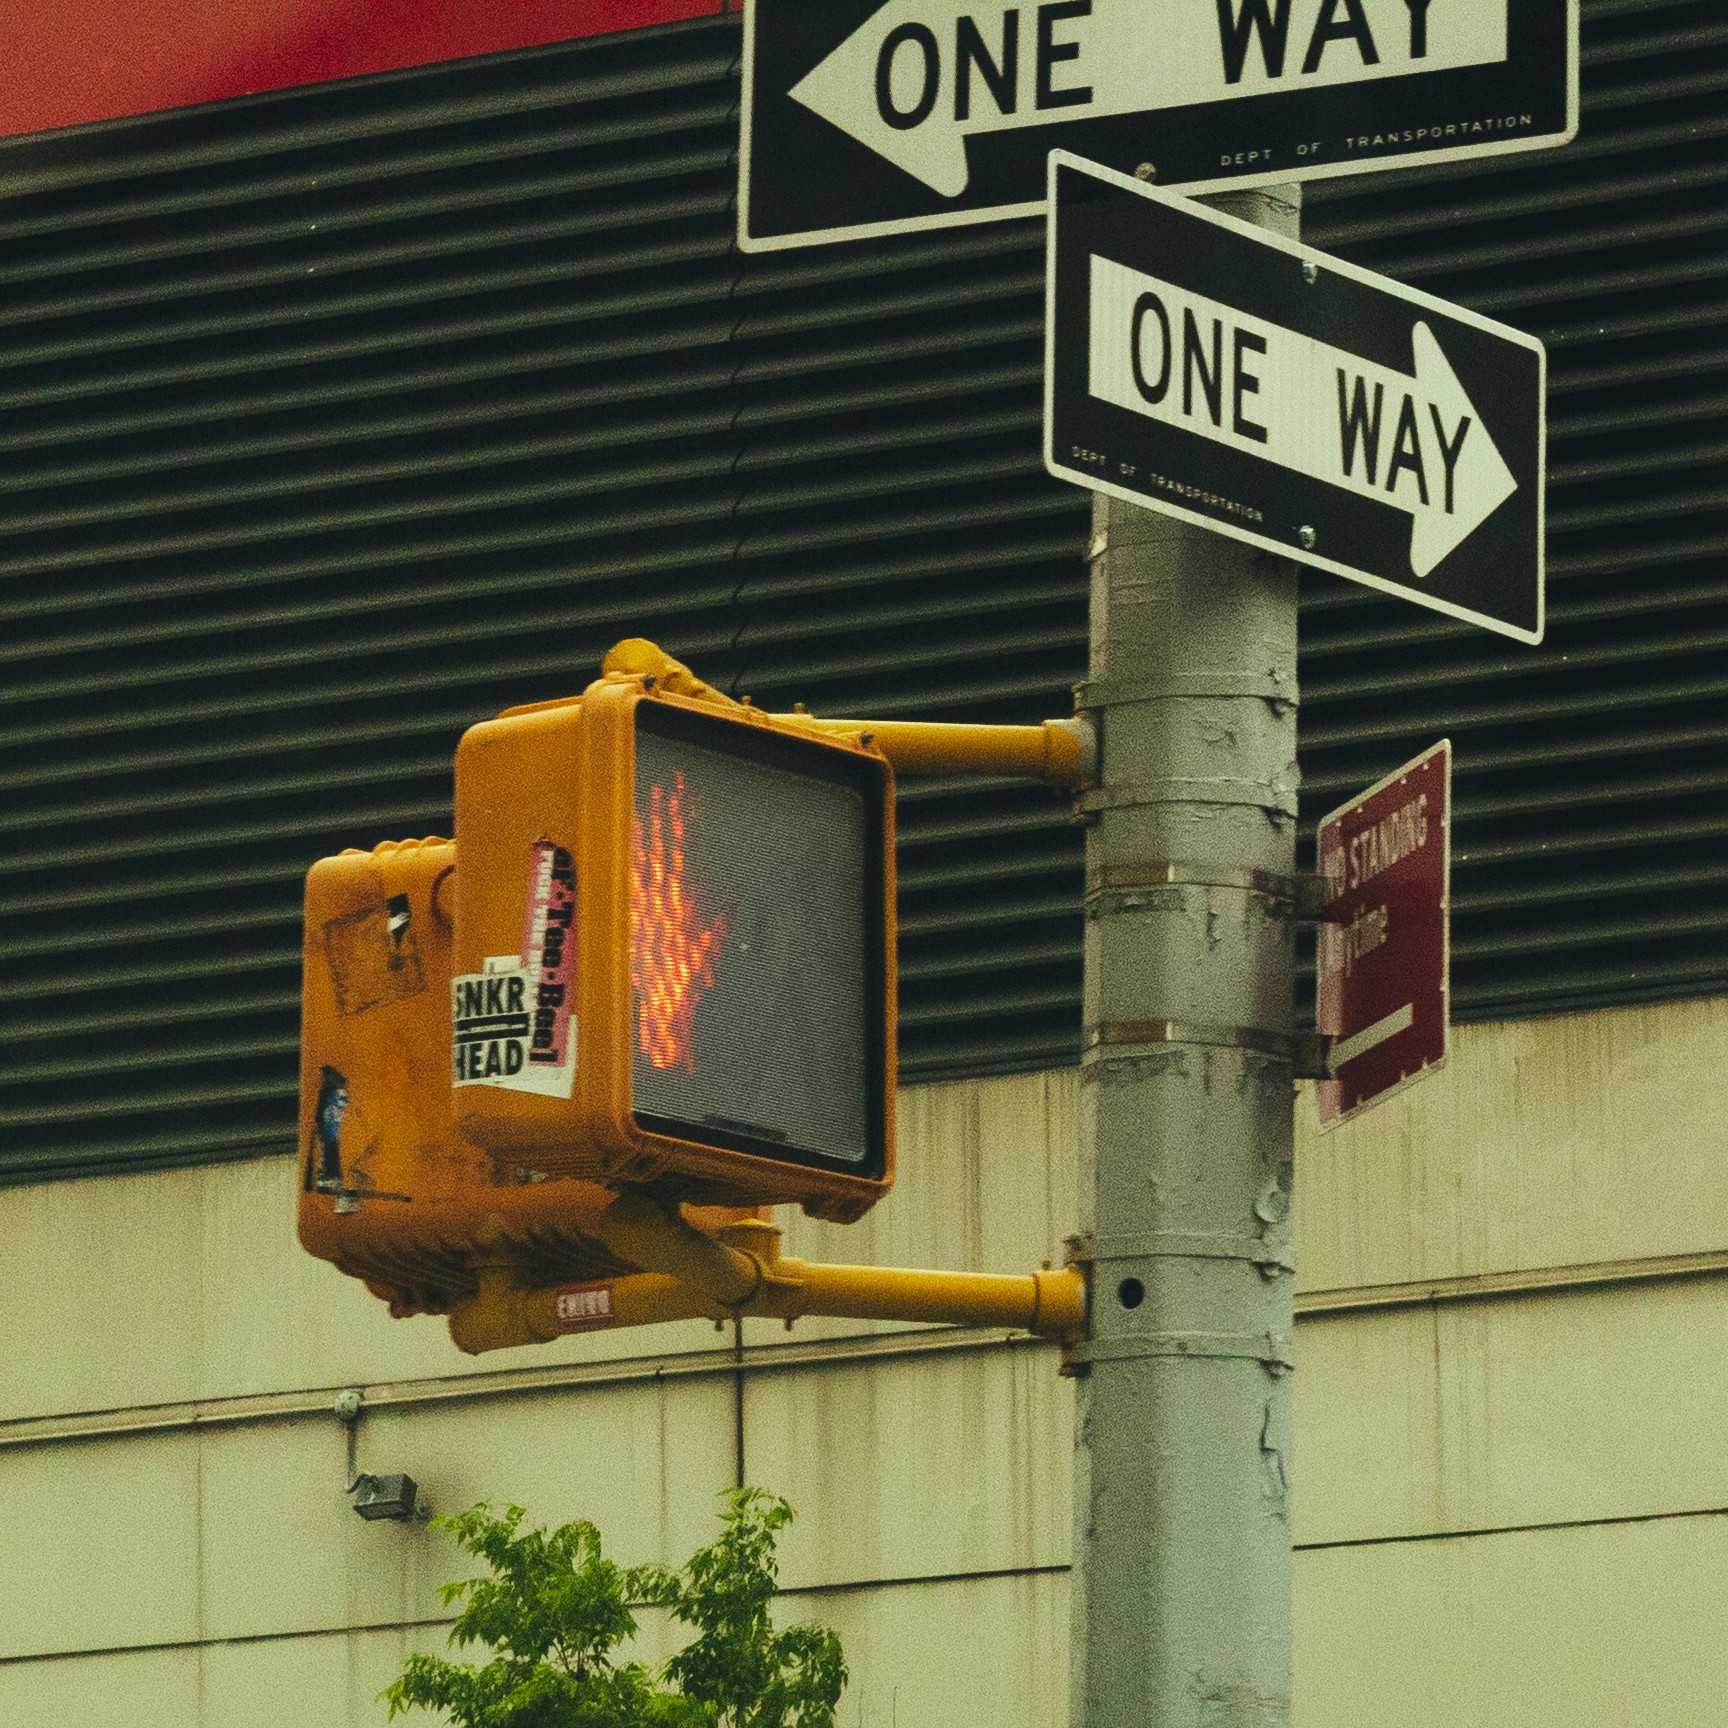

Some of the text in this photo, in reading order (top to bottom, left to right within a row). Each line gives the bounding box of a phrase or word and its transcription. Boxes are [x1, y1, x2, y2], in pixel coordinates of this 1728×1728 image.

[874, 0, 1436, 131] ONE WAY
[1220, 113, 1533, 167] DEPT OF TRANSPORTATION
[1130, 291, 1472, 515] ONE WAY
[1072, 446, 1264, 523] DEPT OF TRANSPORTATION
[1349, 793, 1429, 891] STANDING
